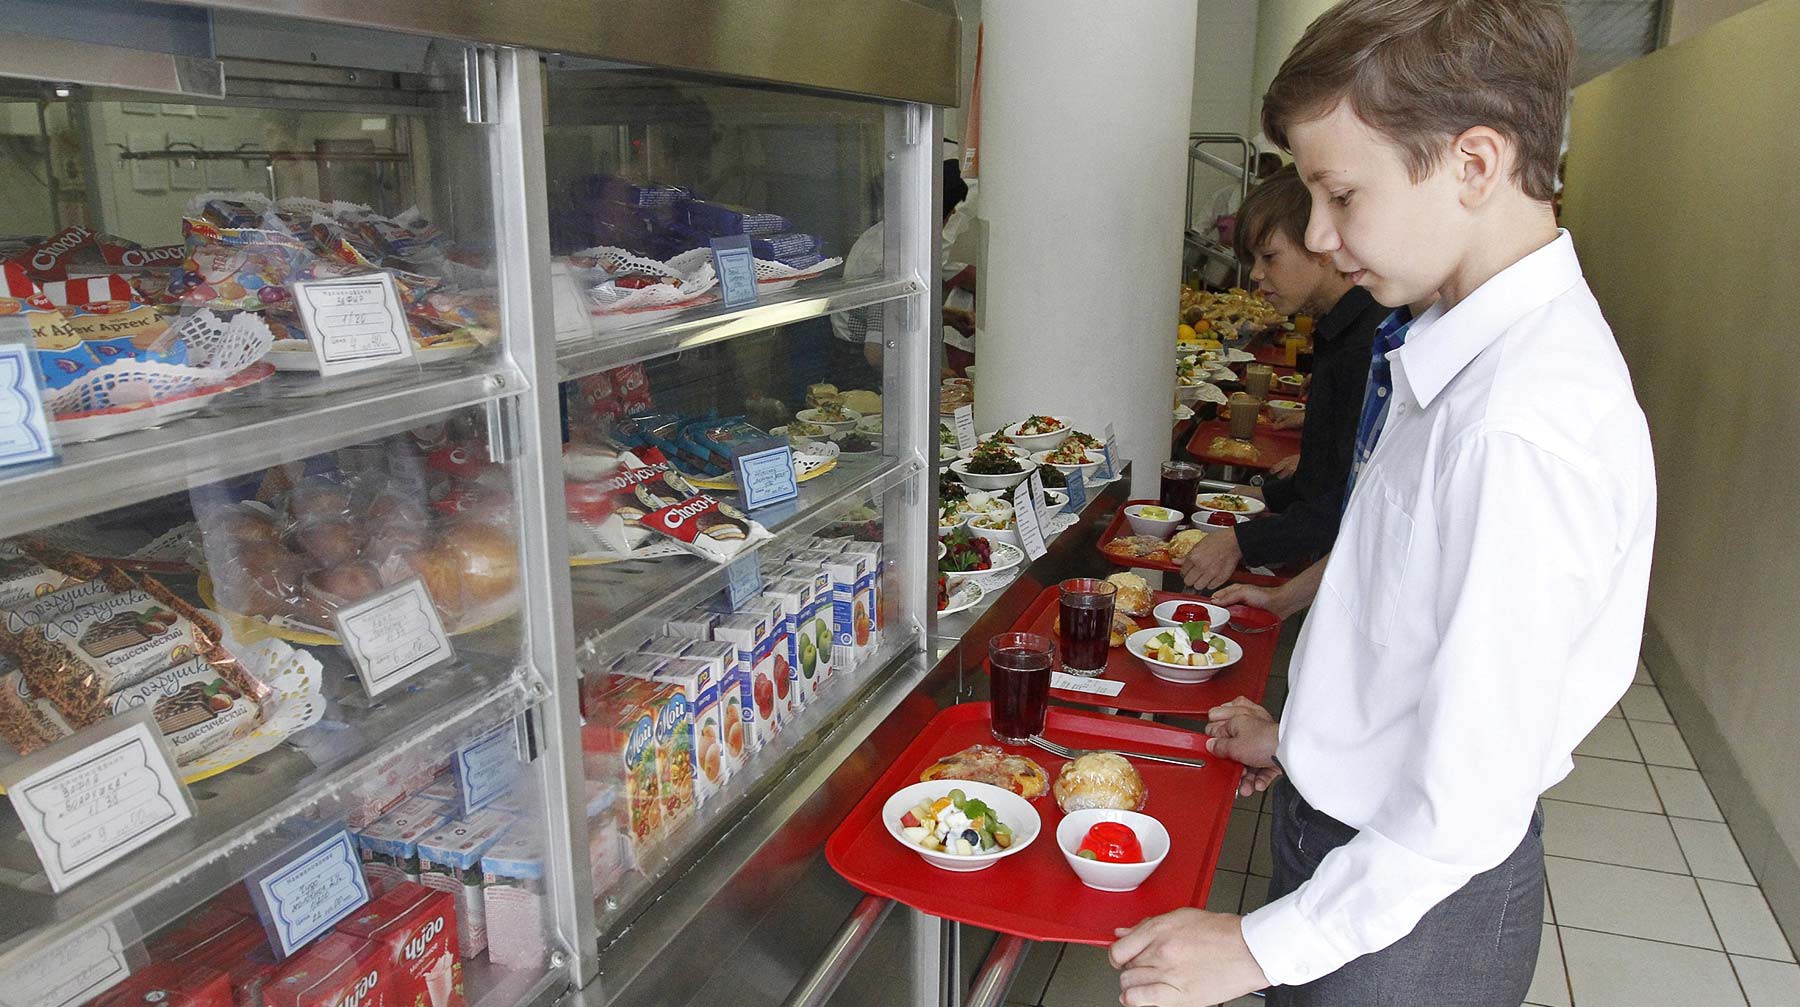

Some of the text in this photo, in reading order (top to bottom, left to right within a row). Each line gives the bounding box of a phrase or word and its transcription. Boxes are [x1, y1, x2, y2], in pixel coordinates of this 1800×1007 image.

[45, 590, 151, 640] Боярушка
[105, 627, 184, 668] Классический
[172, 704, 248, 747] Классический
[405, 916, 444, 960] Чудо
